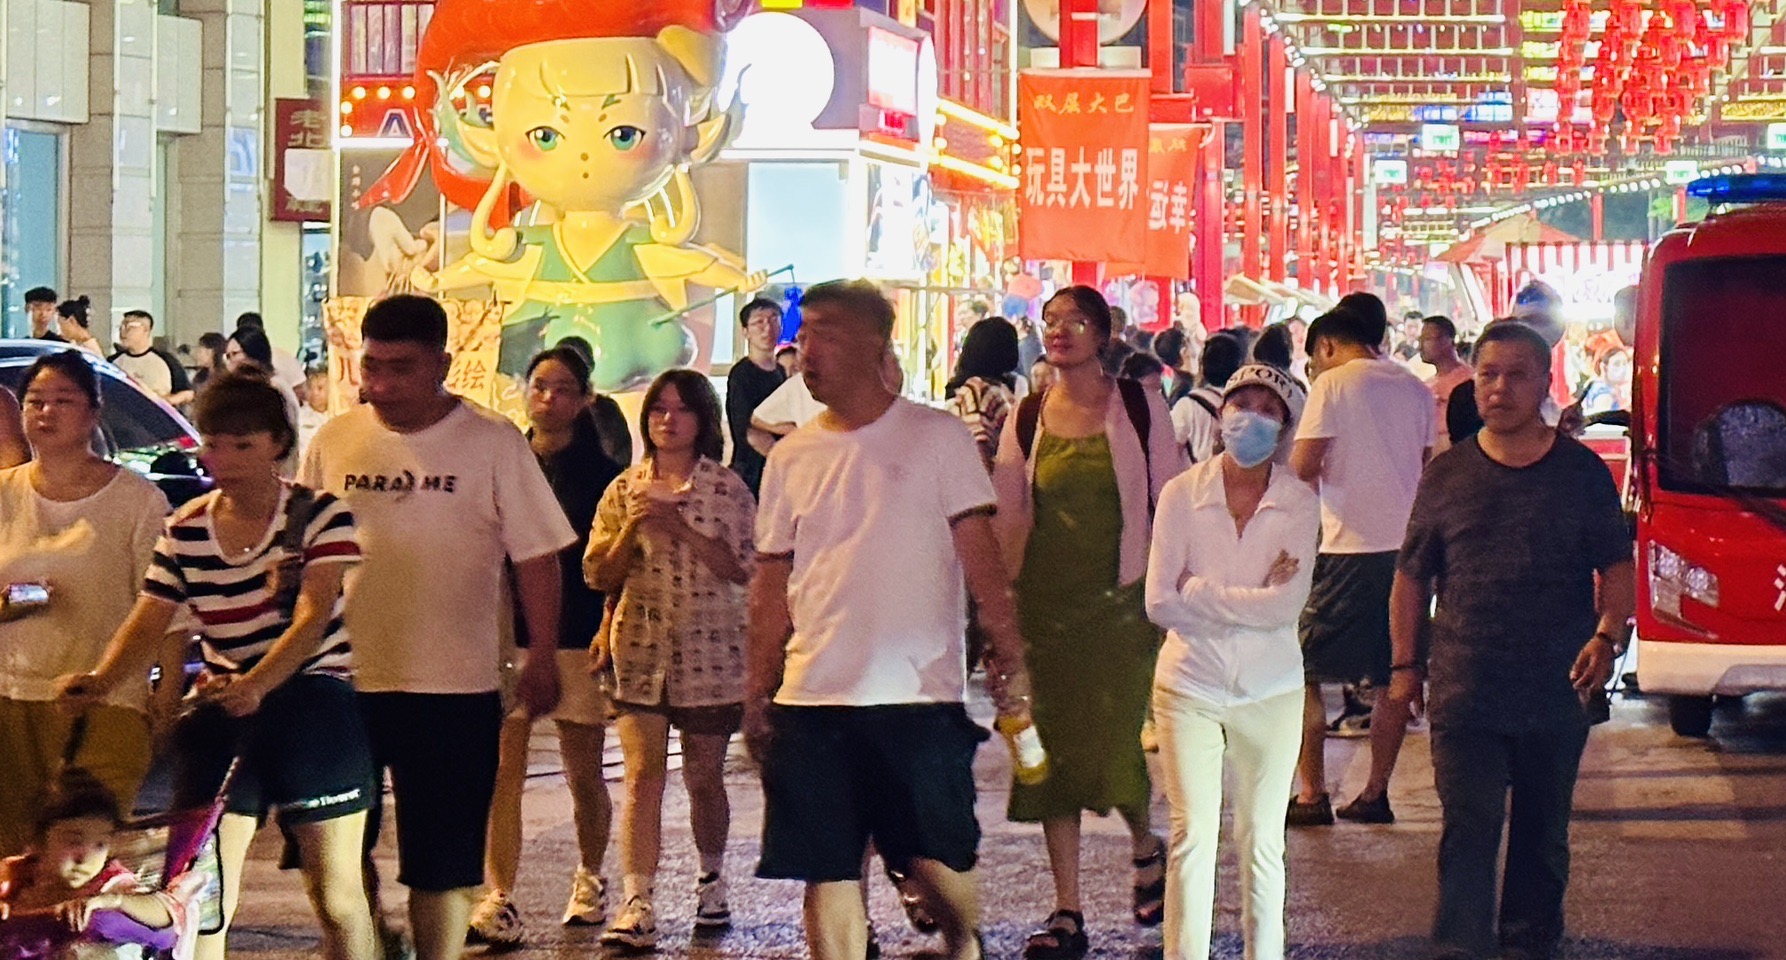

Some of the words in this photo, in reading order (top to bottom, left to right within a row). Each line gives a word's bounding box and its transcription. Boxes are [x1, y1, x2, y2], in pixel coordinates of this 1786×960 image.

[1025, 145, 1139, 210] 玩具大世界
